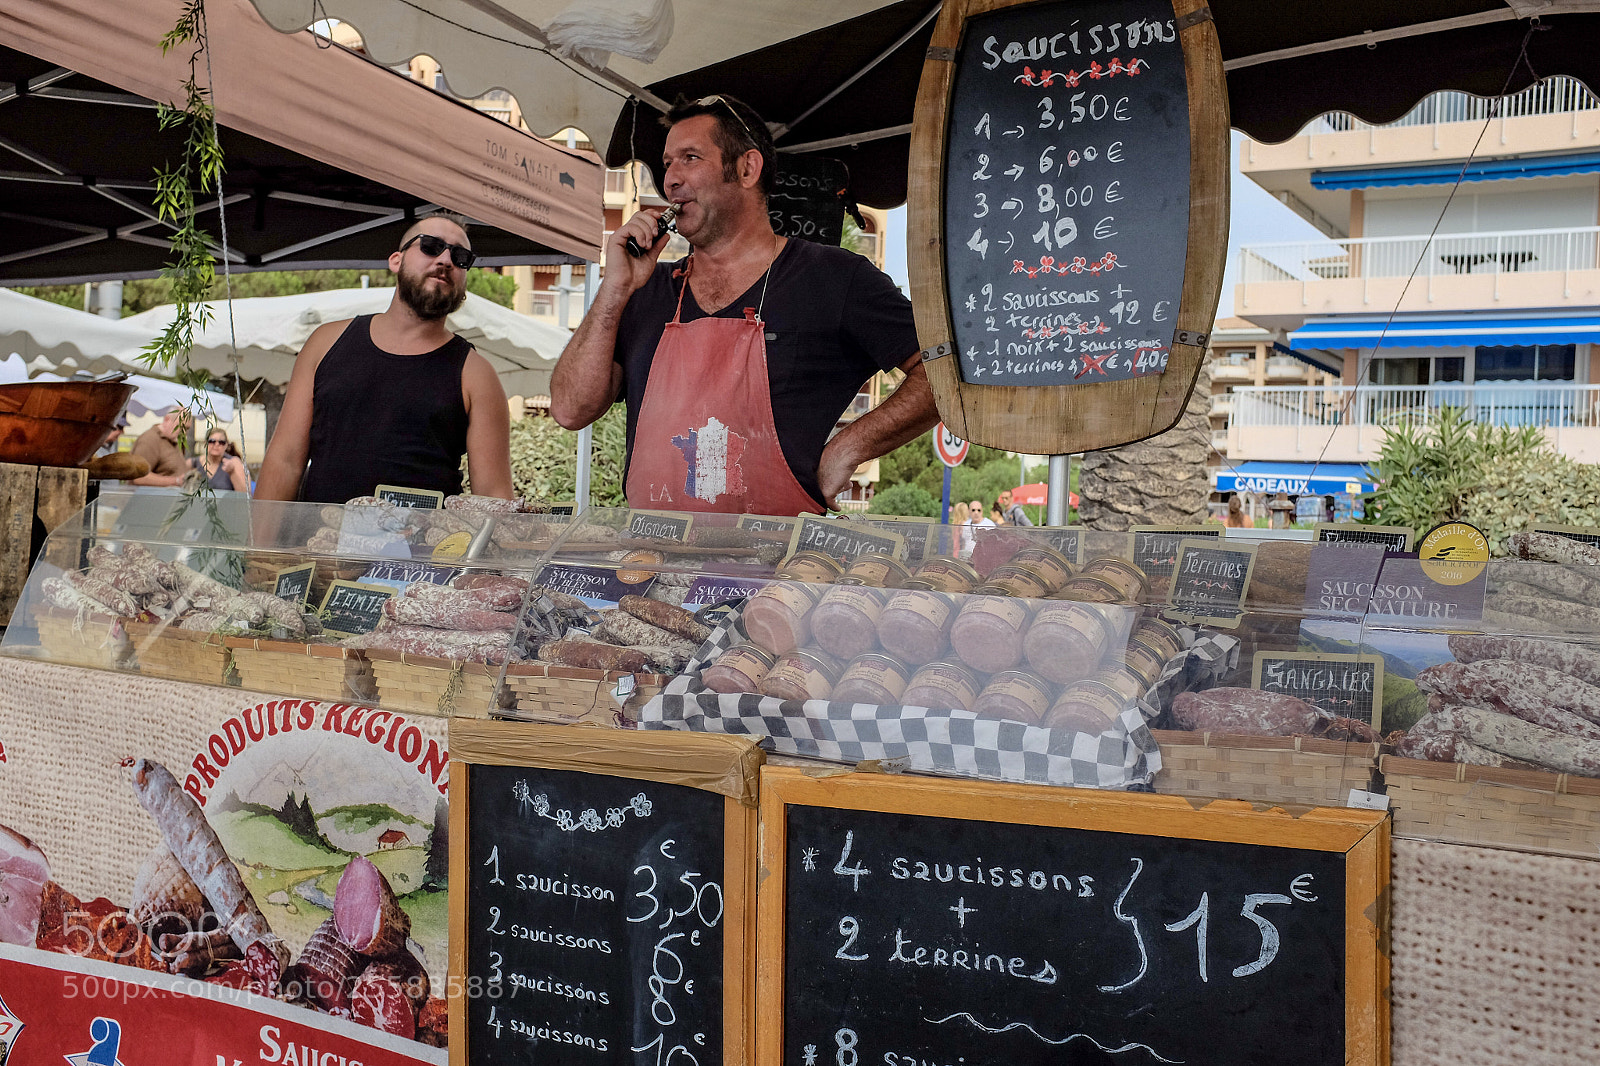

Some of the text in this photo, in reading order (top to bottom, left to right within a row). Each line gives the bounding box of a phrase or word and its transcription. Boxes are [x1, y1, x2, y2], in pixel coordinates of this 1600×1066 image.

[982, 18, 1177, 70] Saucissons
[974, 112, 991, 140] 1
[486, 139, 507, 162] TOM
[972, 153, 992, 181] 2
[973, 193, 990, 218] 3
[967, 216, 1118, 260] 4 10 €
[981, 283, 997, 312] 2
[1109, 300, 1141, 325] 12
[1063, 335, 1077, 353] 2
[991, 360, 1004, 375] 2
[650, 484, 673, 502] LA
[1234, 477, 1309, 494] CADEAUX
[631, 516, 678, 539] Oignon
[1424, 526, 1467, 549] Médaille
[551, 569, 609, 586] SAUCISSON
[562, 579, 588, 590] BLEU
[1321, 580, 1425, 600] SAUCISSON
[1319, 595, 1458, 620] SEC NATURE
[184, 699, 320, 807] PRODUITS
[660, 839, 676, 859] €
[833, 830, 1096, 898] 4 saucissons
[484, 845, 724, 930] 1 saucisson 3,50
[835, 916, 869, 961] 2
[1164, 873, 1319, 983] 15 €
[487, 906, 506, 935] 2
[511, 924, 612, 954] saucissons
[653, 933, 684, 985] 6
[489, 951, 503, 983] 3
[509, 970, 610, 1005] saucissons
[649, 974, 676, 1025] 8
[487, 1005, 504, 1039] 4
[510, 1018, 609, 1052] saucissons
